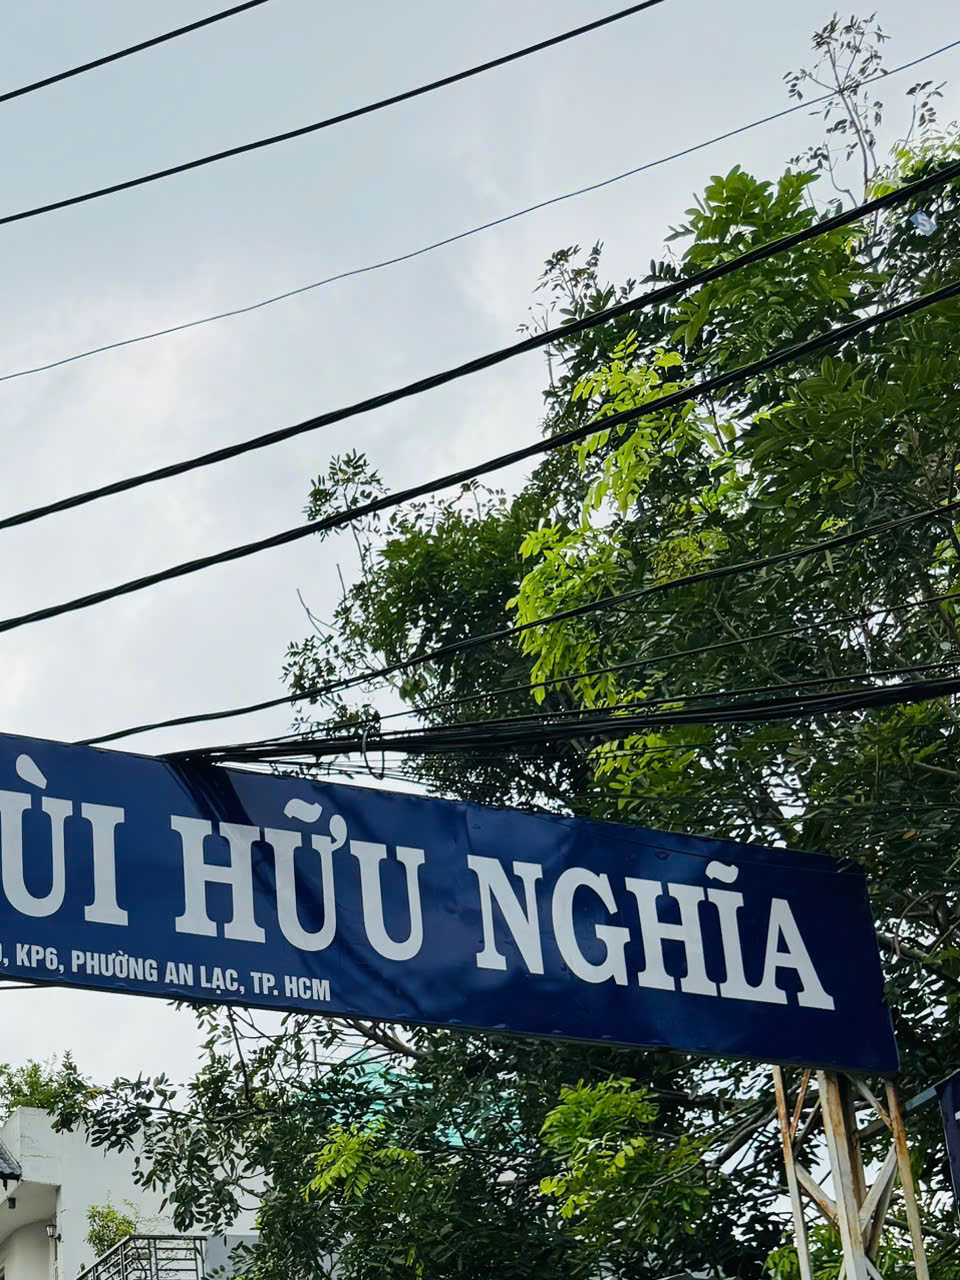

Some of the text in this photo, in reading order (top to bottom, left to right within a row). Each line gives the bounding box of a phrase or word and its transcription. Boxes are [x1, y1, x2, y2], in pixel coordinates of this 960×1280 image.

[16, 943, 65, 973] KP6,
[71, 950, 158, 982] PHƯỜNG
[165, 961, 194, 986] AN
[201, 965, 245, 995] LẠC,
[250, 971, 279, 996] TP.
[285, 975, 331, 1002] HCM
[171, 798, 426, 961] HỮU
[468, 854, 835, 1011] NGHĨA
